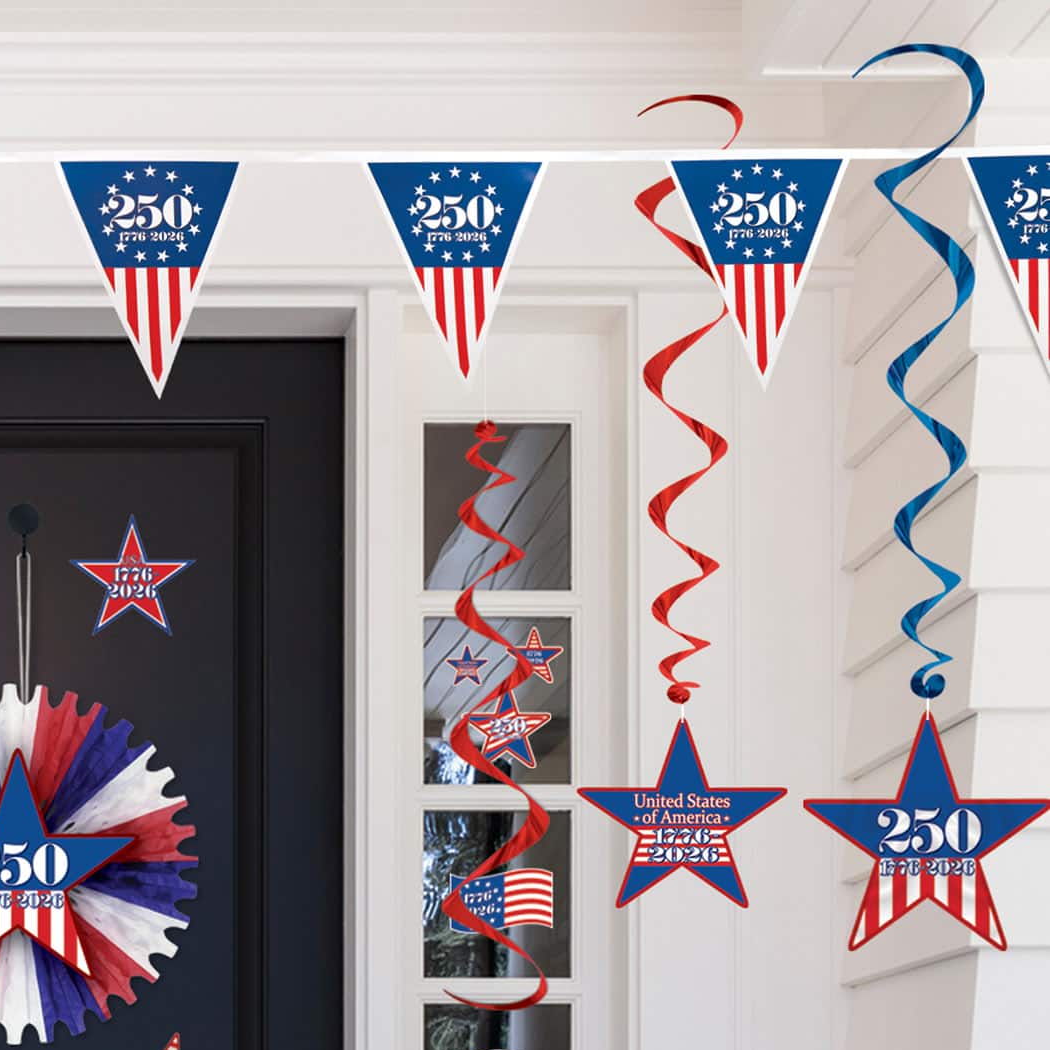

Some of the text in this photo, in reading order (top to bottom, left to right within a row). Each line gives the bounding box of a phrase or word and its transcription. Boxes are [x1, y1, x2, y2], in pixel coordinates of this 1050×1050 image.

[108, 194, 193, 229] 250
[416, 194, 495, 230] 250
[718, 192, 797, 227] 250
[107, 583, 157, 599] 2026
[634, 792, 731, 809] United States
[642, 808, 721, 825] of America
[877, 808, 982, 854] 250
[646, 846, 719, 864] 2026
